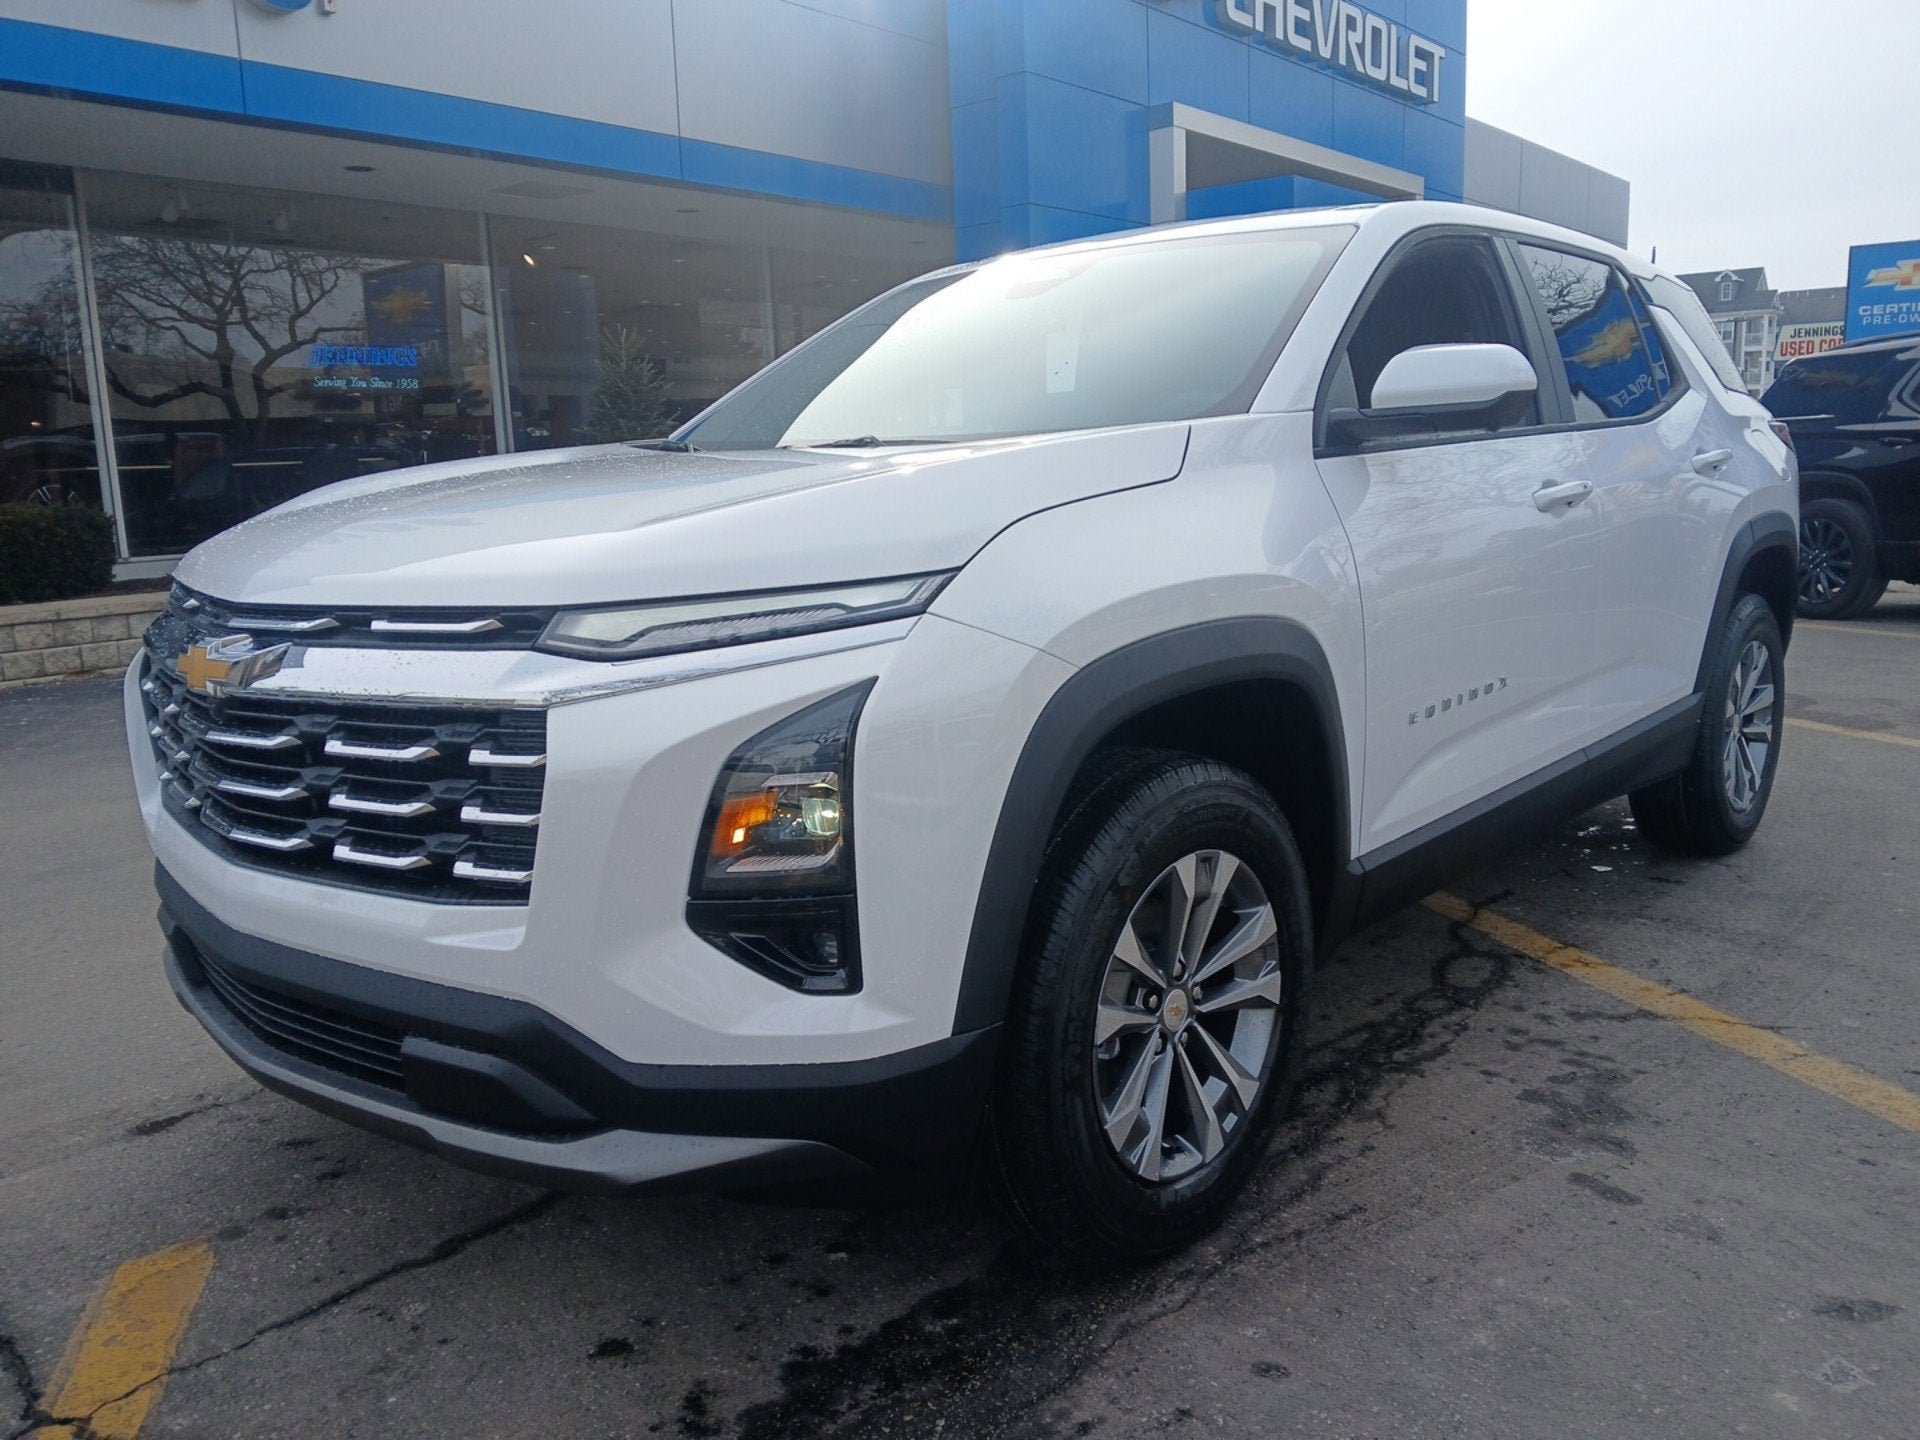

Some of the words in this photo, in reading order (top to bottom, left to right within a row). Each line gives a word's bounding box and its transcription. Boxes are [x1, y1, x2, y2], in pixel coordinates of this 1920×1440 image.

[1858, 302, 1920, 316] CERTI
[312, 345, 418, 367] JENNINGS
[1780, 340, 1815, 357] USED
[313, 376, 348, 390] Serving
[349, 376, 367, 388] You
[369, 376, 393, 389] Since
[396, 378, 419, 389] 1958
[1408, 677, 1508, 726] EQUINOX
